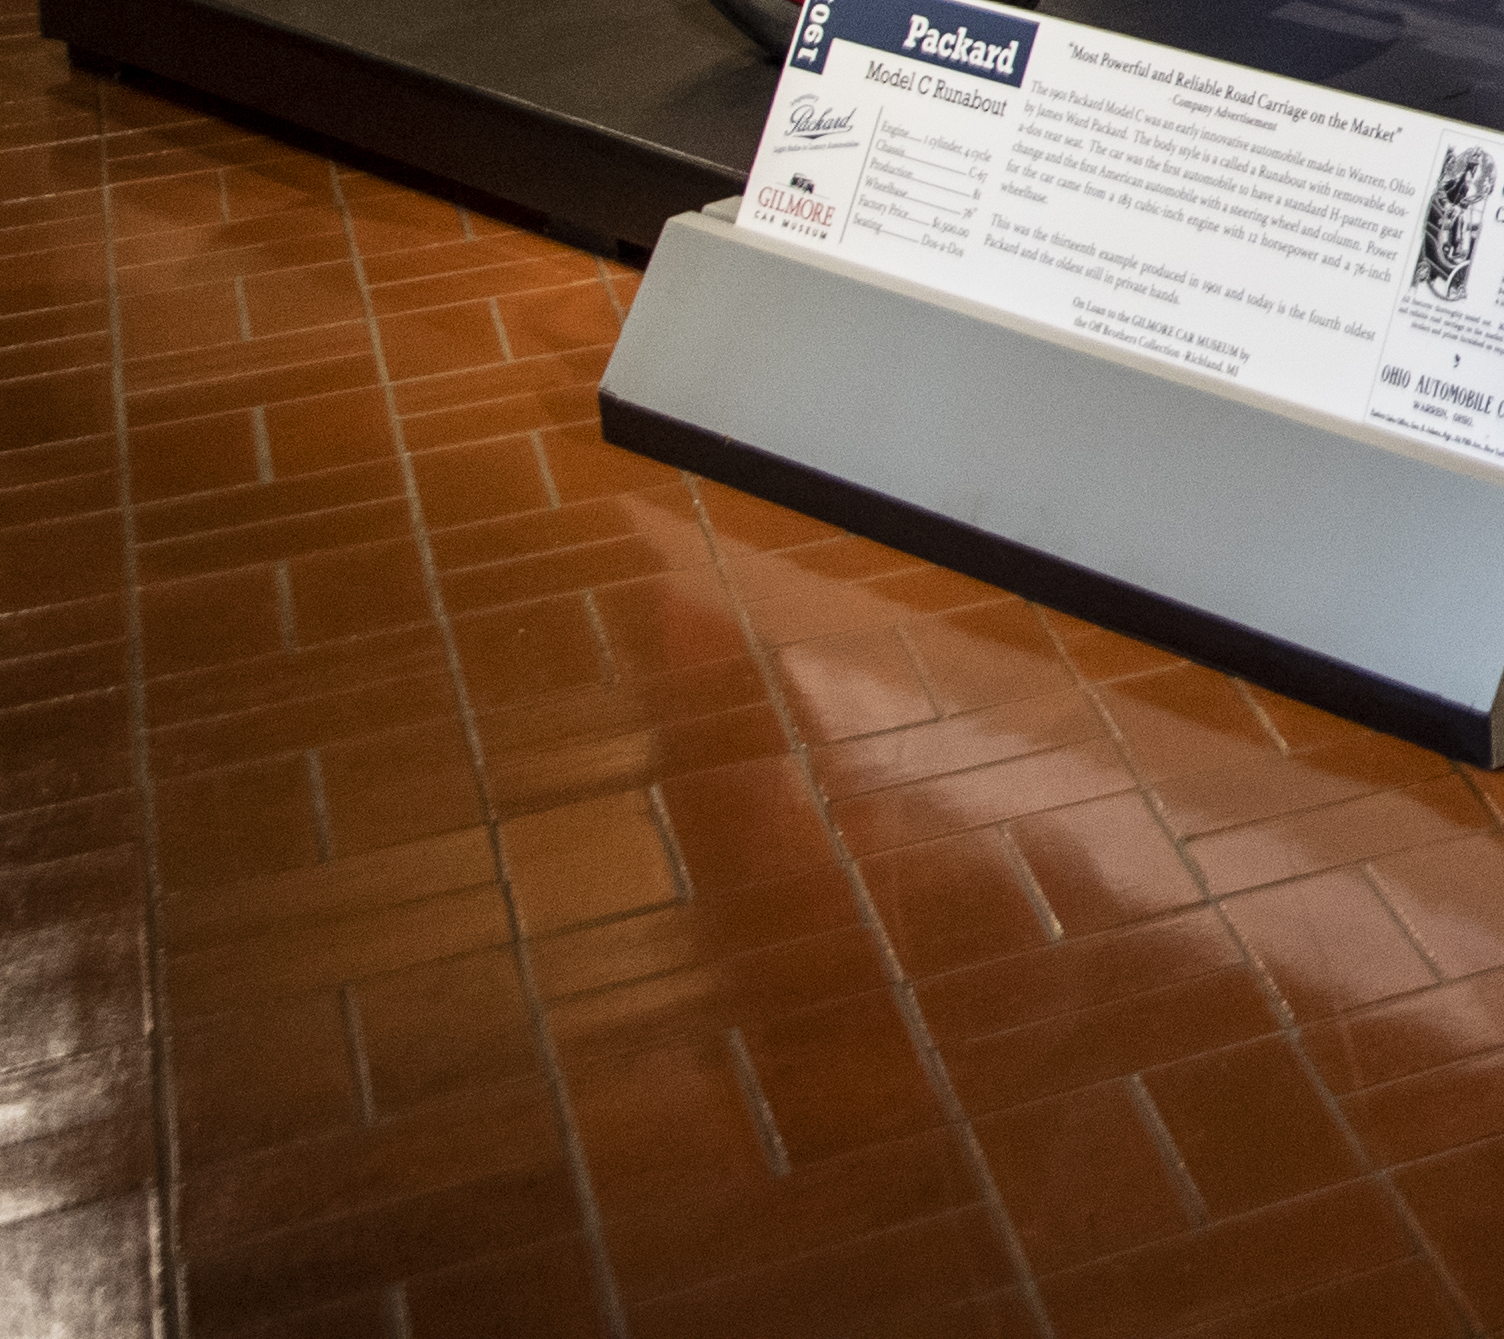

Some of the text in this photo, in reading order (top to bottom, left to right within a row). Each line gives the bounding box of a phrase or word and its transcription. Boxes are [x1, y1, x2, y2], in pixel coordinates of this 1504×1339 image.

[904, 15, 1017, 73] Packard
[865, 60, 1007, 116] Model C Runabout
[1099, 52, 1151, 77] Powerful
[1150, 69, 1175, 84] and
[1174, 71, 1222, 96] Reliable
[1223, 84, 1256, 105] Road
[1256, 93, 1308, 122] Carriage
[1309, 111, 1326, 124] on
[1327, 111, 1348, 130] the
[784, 104, 857, 136] Packard
[753, 209, 827, 239] CAR MUSEUM
[757, 186, 835, 226] GILMORE
[1380, 364, 1411, 388] OHIO
[1415, 375, 1493, 414] AUTOMOBILE
